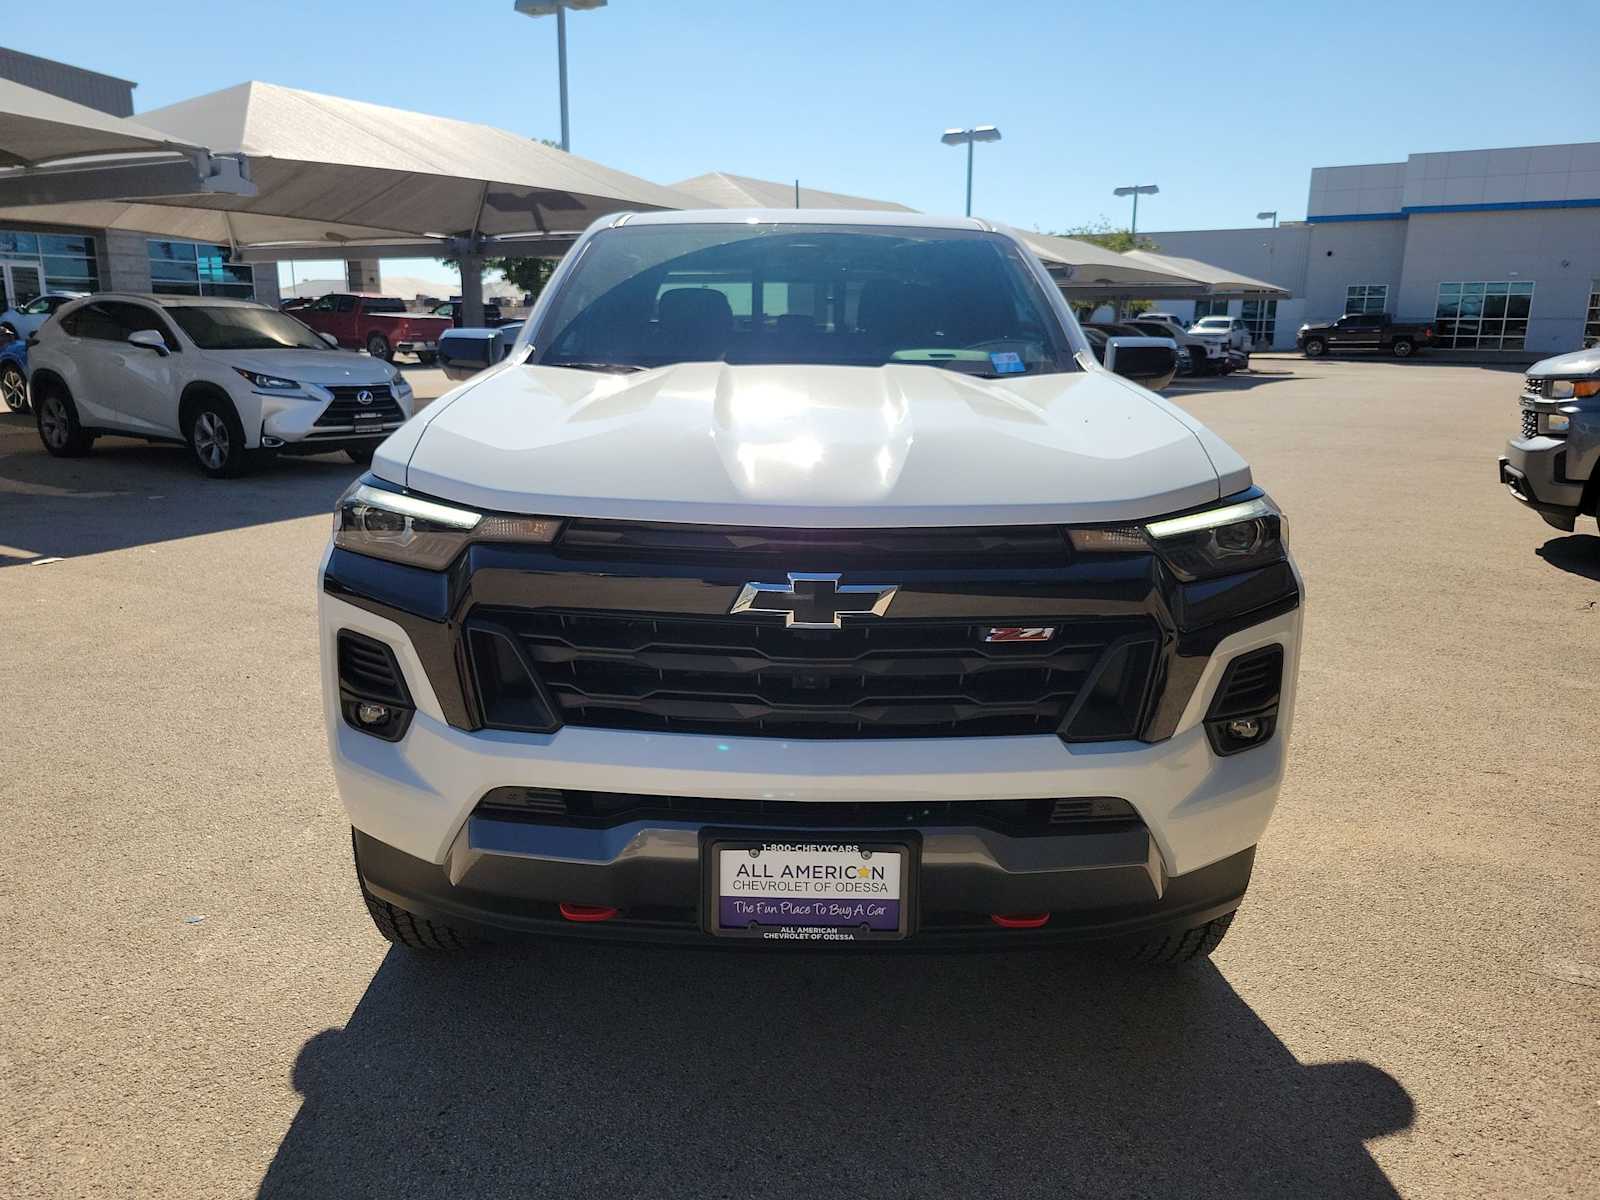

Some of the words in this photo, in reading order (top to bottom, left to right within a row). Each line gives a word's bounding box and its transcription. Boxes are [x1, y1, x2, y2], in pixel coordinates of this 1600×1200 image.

[736, 864, 774, 878] ALL
[780, 864, 885, 880] AMERICN
[733, 880, 812, 892] CHEVROLET
[814, 881, 833, 892] OF
[835, 882, 888, 893] ODESSA
[734, 901, 754, 914] The
[756, 901, 778, 914] Fun
[780, 901, 811, 914] Place
[813, 903, 827, 914] To
[829, 903, 852, 919] Buy
[853, 904, 865, 916] A
[866, 904, 887, 916] Car
[763, 932, 810, 940] CHEVROLET
[823, 933, 855, 941] ODESSA
